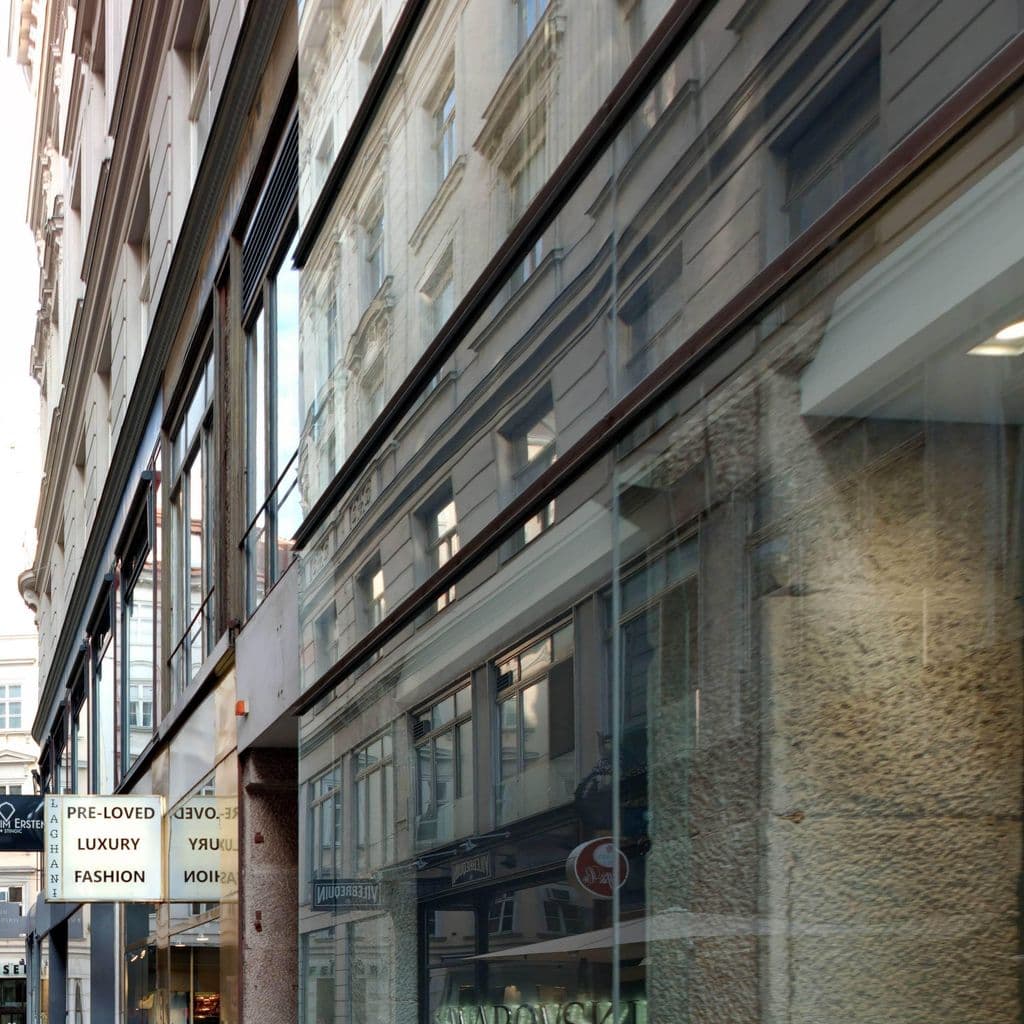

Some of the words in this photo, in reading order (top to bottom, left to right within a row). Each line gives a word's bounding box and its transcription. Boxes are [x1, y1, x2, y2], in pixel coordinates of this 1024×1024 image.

[67, 806, 155, 819] PRE-LOVED
[0, 821, 11, 829] IM
[50, 798, 59, 898] LAGHANI
[78, 838, 140, 850] LUXURY
[75, 870, 145, 883] FASHION
